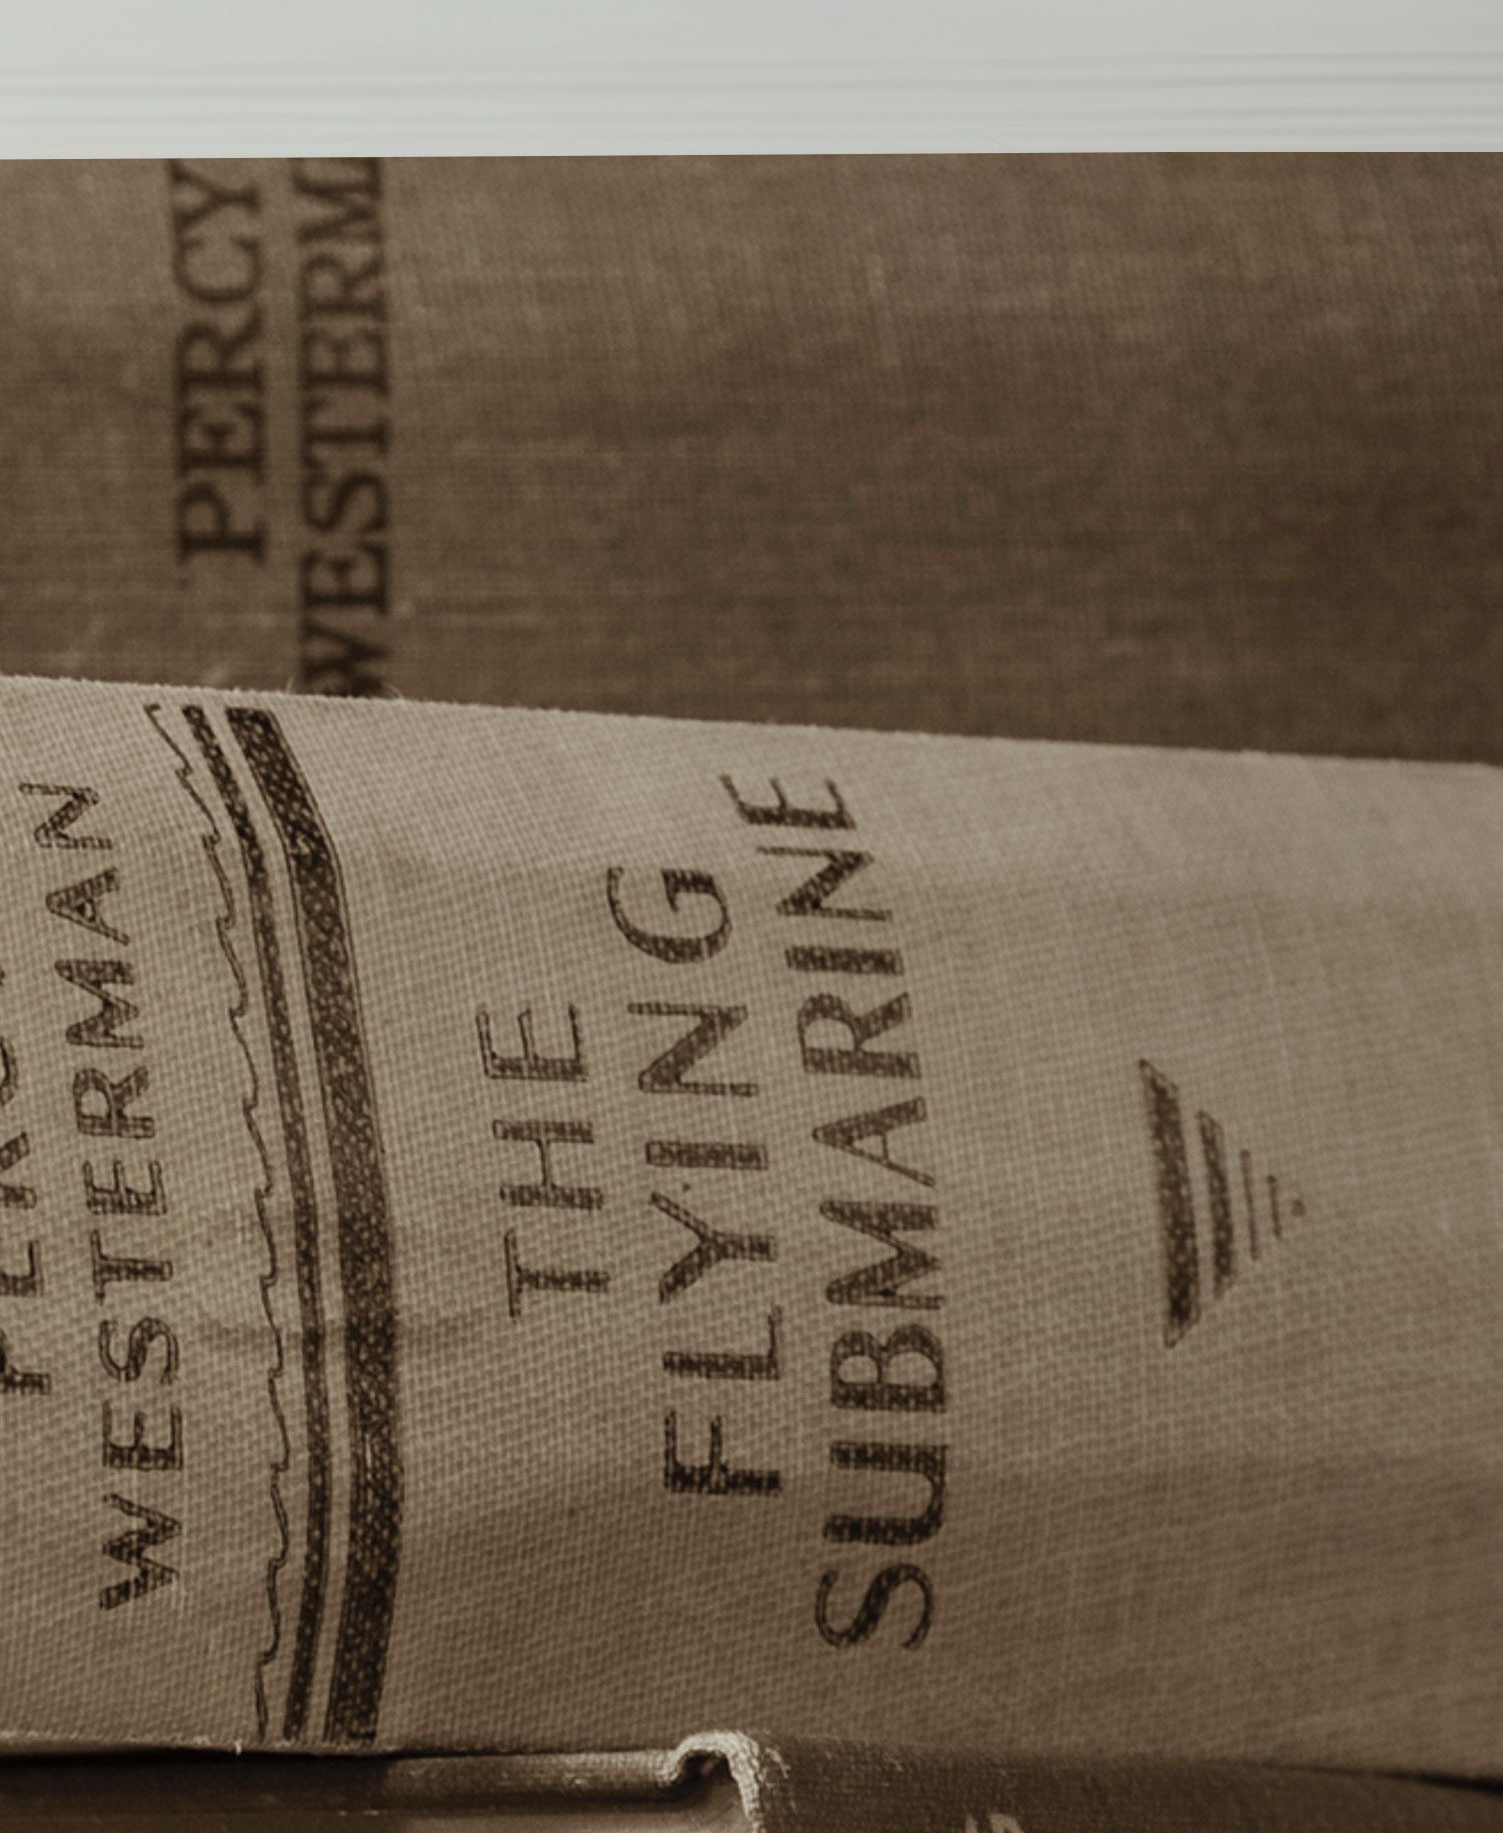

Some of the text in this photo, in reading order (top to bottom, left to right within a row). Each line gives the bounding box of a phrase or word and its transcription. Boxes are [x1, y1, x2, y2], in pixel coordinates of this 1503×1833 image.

[168, 158, 266, 569] PERCY
[19, 781, 184, 1610] WESTERMAN
[475, 1003, 610, 1319] THE
[606, 865, 783, 1498] FLYING
[719, 771, 948, 1650] SUBMARINE
